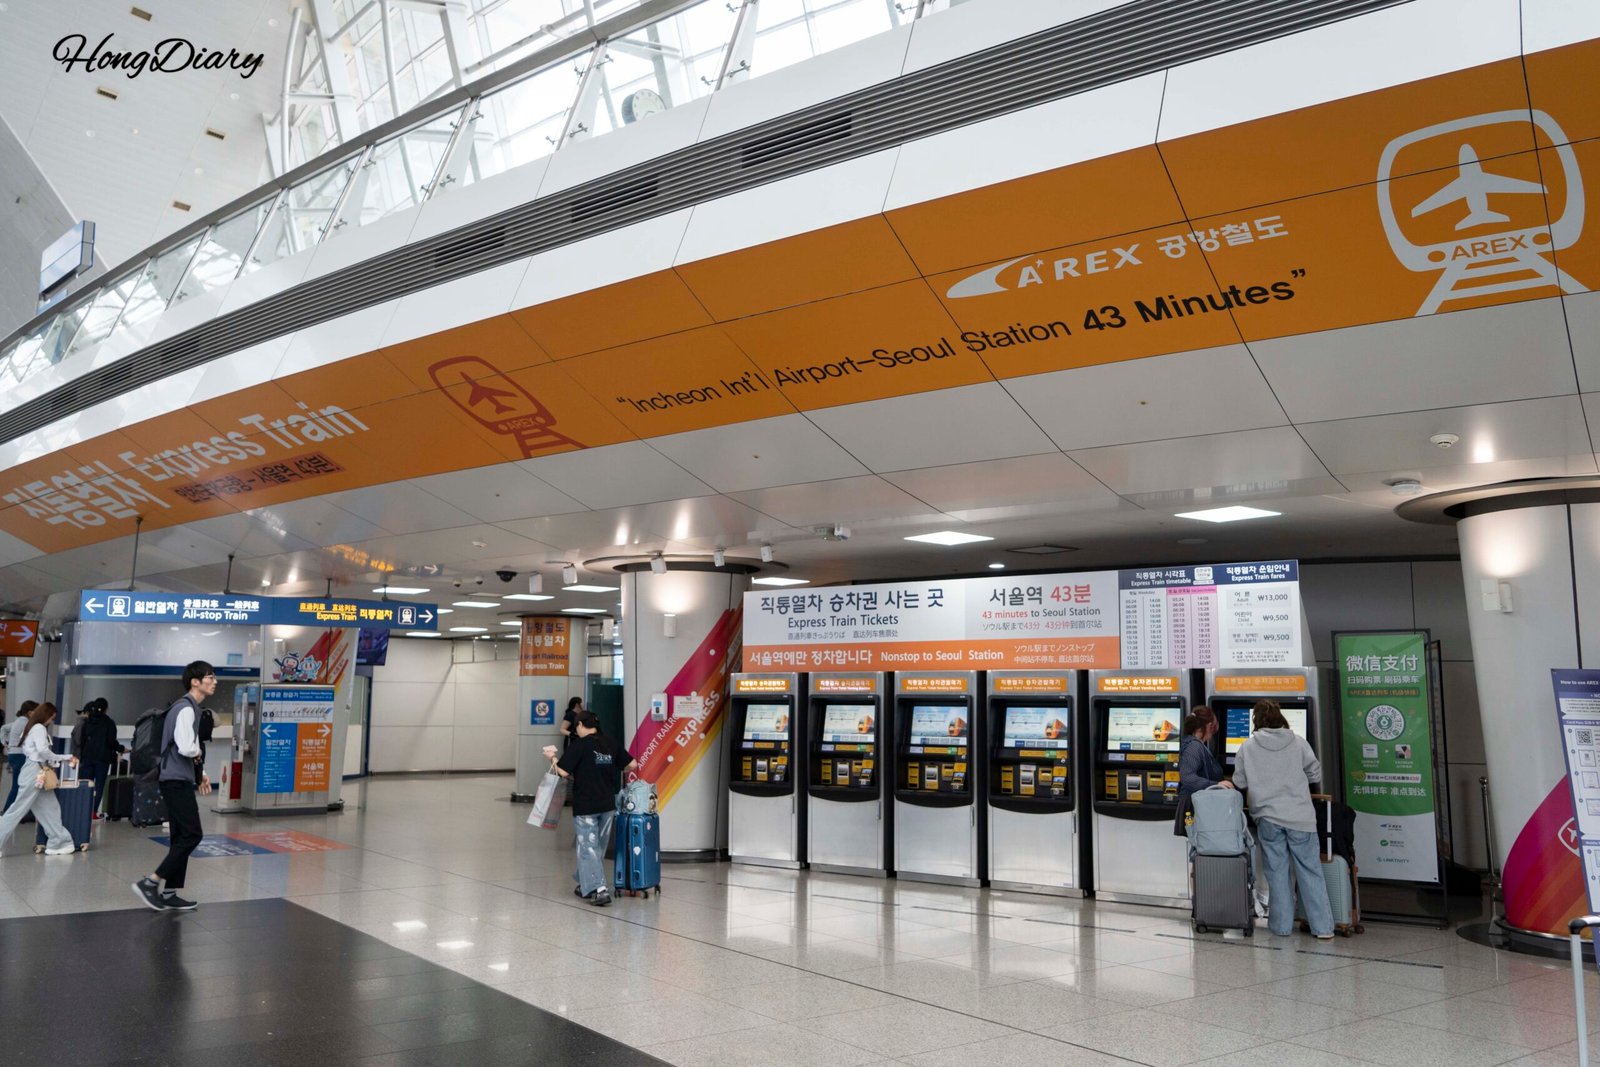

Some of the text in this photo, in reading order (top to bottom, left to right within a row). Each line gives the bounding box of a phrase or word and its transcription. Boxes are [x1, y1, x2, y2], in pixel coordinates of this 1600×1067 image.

[1017, 215, 1289, 289] AREX 공항철도
[1451, 234, 1529, 261] AREX
[960, 320, 1072, 353] Station
[1083, 304, 1127, 331] 43
[118, 431, 267, 482] Express
[239, 402, 370, 450] Train
[1231, 574, 1254, 582] Express
[761, 587, 944, 615] 직통열차 승차권 사는 곳
[990, 584, 1092, 606] 서울역 43분
[134, 600, 178, 614] 일반열차
[183, 609, 249, 621] All-stop Train
[982, 606, 1101, 619] 43 minutes to Seoul Station
[341, 613, 357, 621] Train
[788, 613, 899, 630] Express Train Tickets
[750, 650, 808, 666] 서울역에만
[811, 648, 873, 664] 정차합니다
[880, 649, 1004, 663] Nonstop to Seoul Station
[1346, 655, 1418, 672] 微信支付
[549, 662, 565, 670] Train
[675, 690, 720, 748] EXPRESS
[638, 737, 658, 771] AIRPORT
